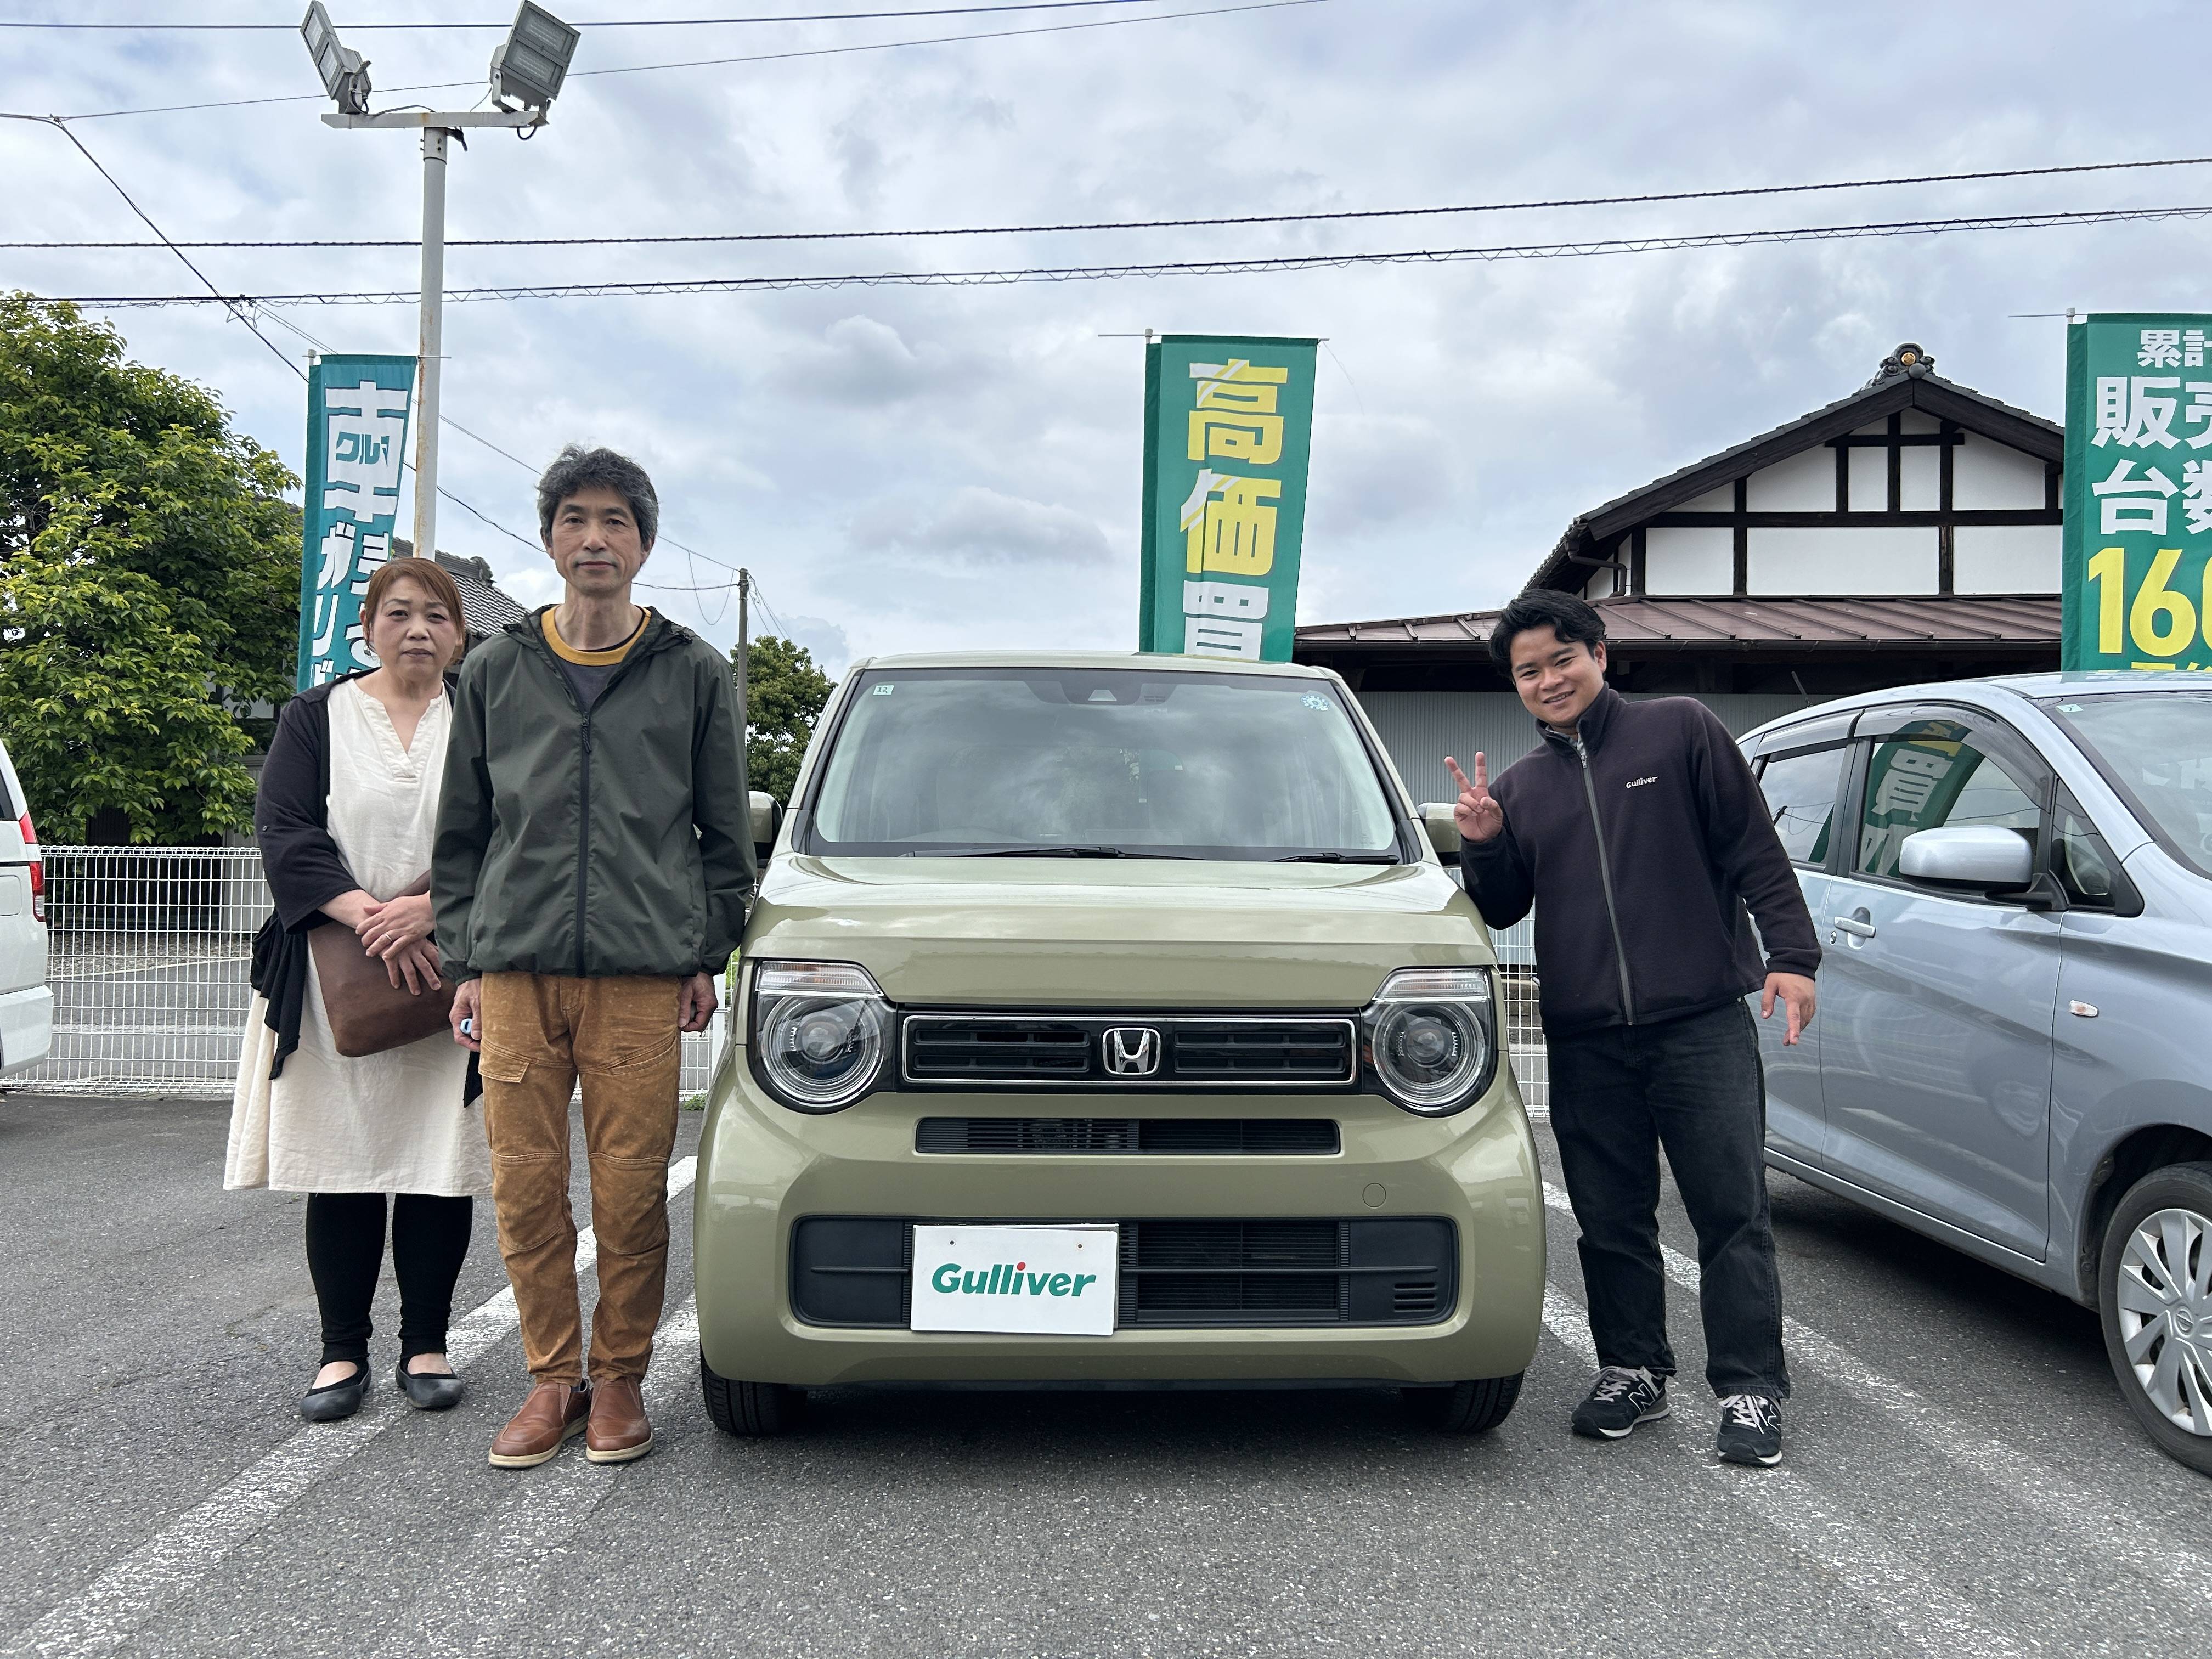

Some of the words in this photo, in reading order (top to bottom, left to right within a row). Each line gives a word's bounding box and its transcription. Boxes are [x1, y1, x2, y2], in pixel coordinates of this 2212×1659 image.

[2088, 548, 2212, 657] 16
[1626, 776, 1658, 788] Gulliver
[932, 1261, 1096, 1297] Gulliver
